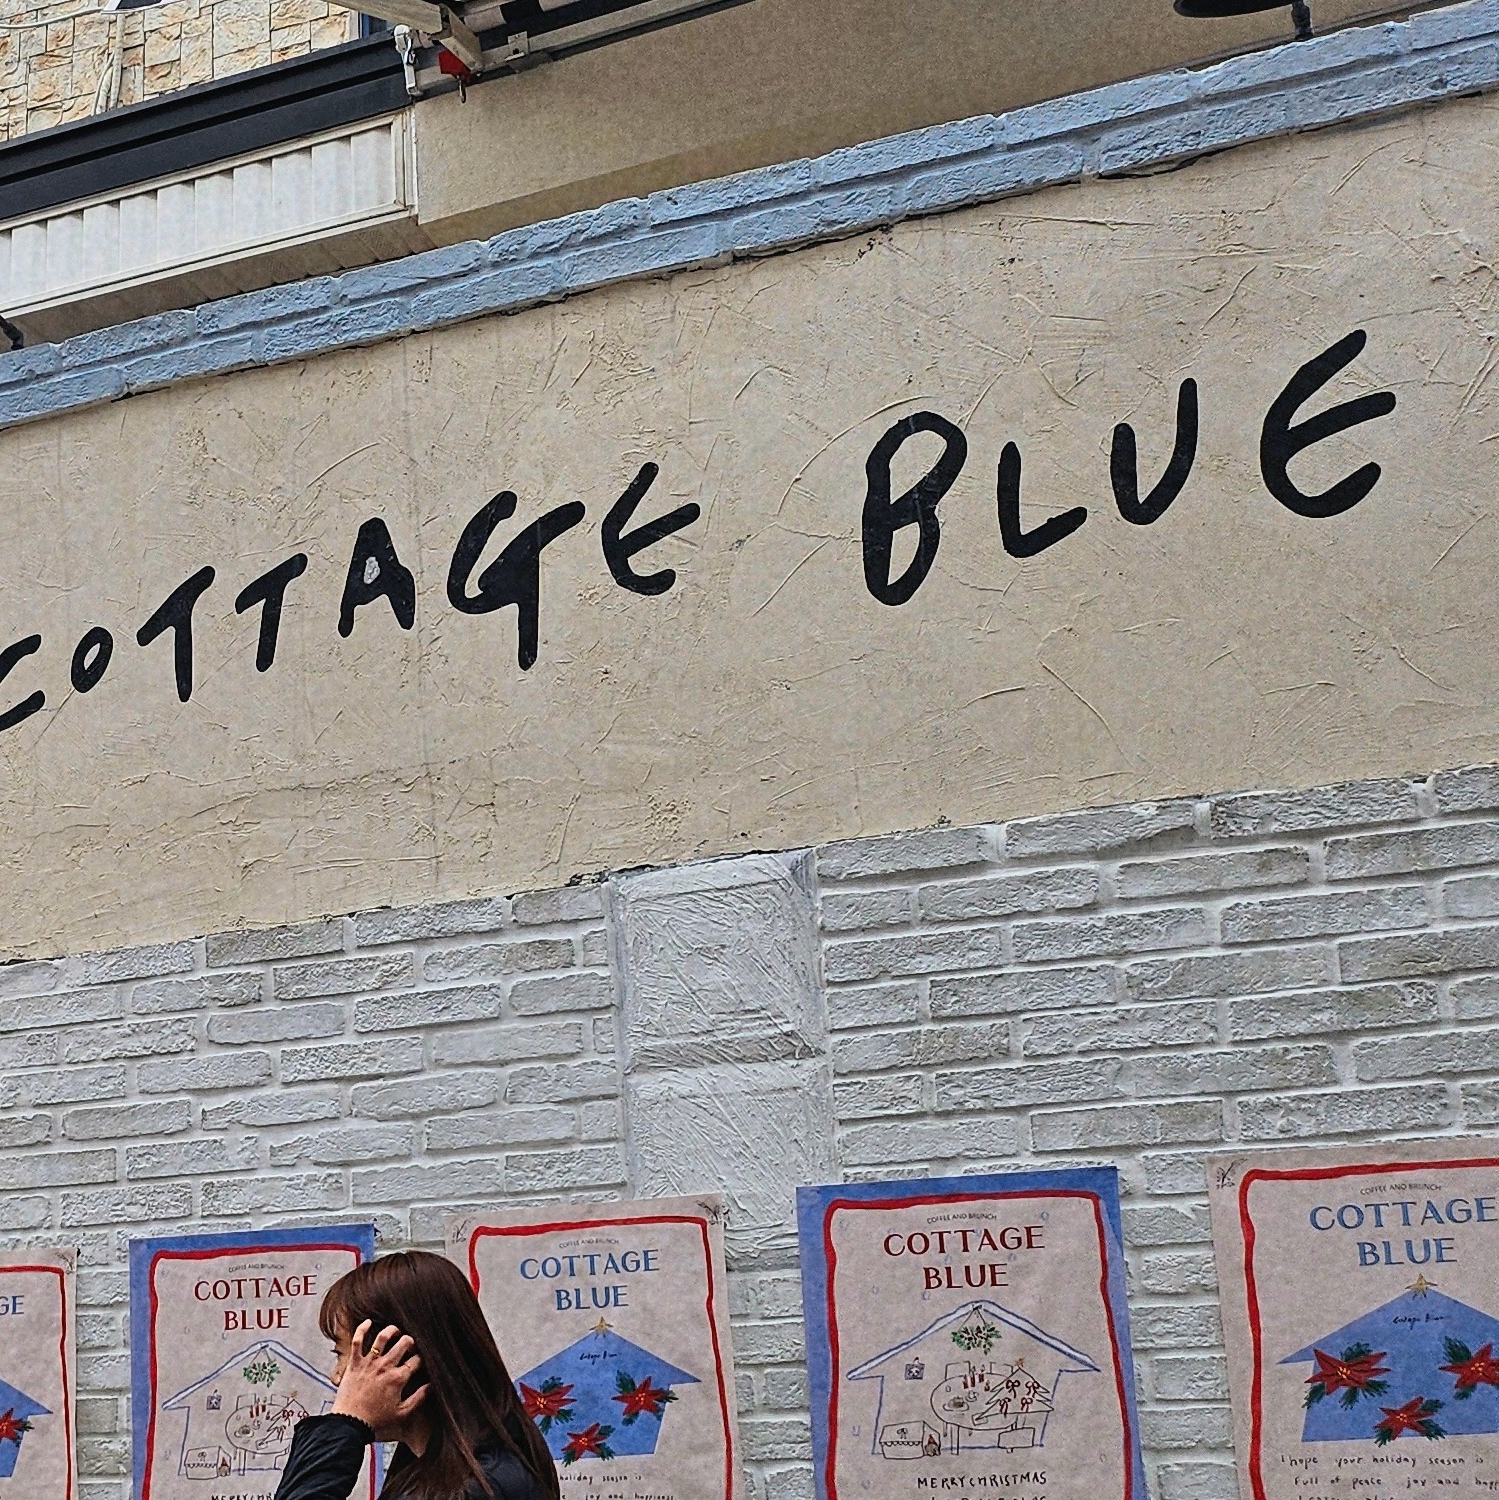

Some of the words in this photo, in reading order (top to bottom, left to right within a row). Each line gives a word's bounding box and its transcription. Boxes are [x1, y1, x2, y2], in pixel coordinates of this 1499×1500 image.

[862, 330, 1396, 607] BLUE
[1310, 1196, 1498, 1231] COTTAGE
[883, 1225, 1046, 1257] COTTAGE
[1358, 1238, 1458, 1267] BLUE
[520, 1249, 660, 1280] COTTAGE
[923, 1262, 1009, 1291] BLUE
[195, 1275, 318, 1301] COTTAGE
[555, 1284, 630, 1311] BLUE
[224, 1308, 290, 1331] BLUE
[1335, 1456, 1363, 1468] your
[1372, 1454, 1417, 1468] holiday
[1476, 1456, 1484, 1464] is
[1330, 1476, 1341, 1485] of
[1352, 1478, 1382, 1490] peace
[1407, 1477, 1427, 1489] joy
[1438, 1478, 1460, 1486] and
